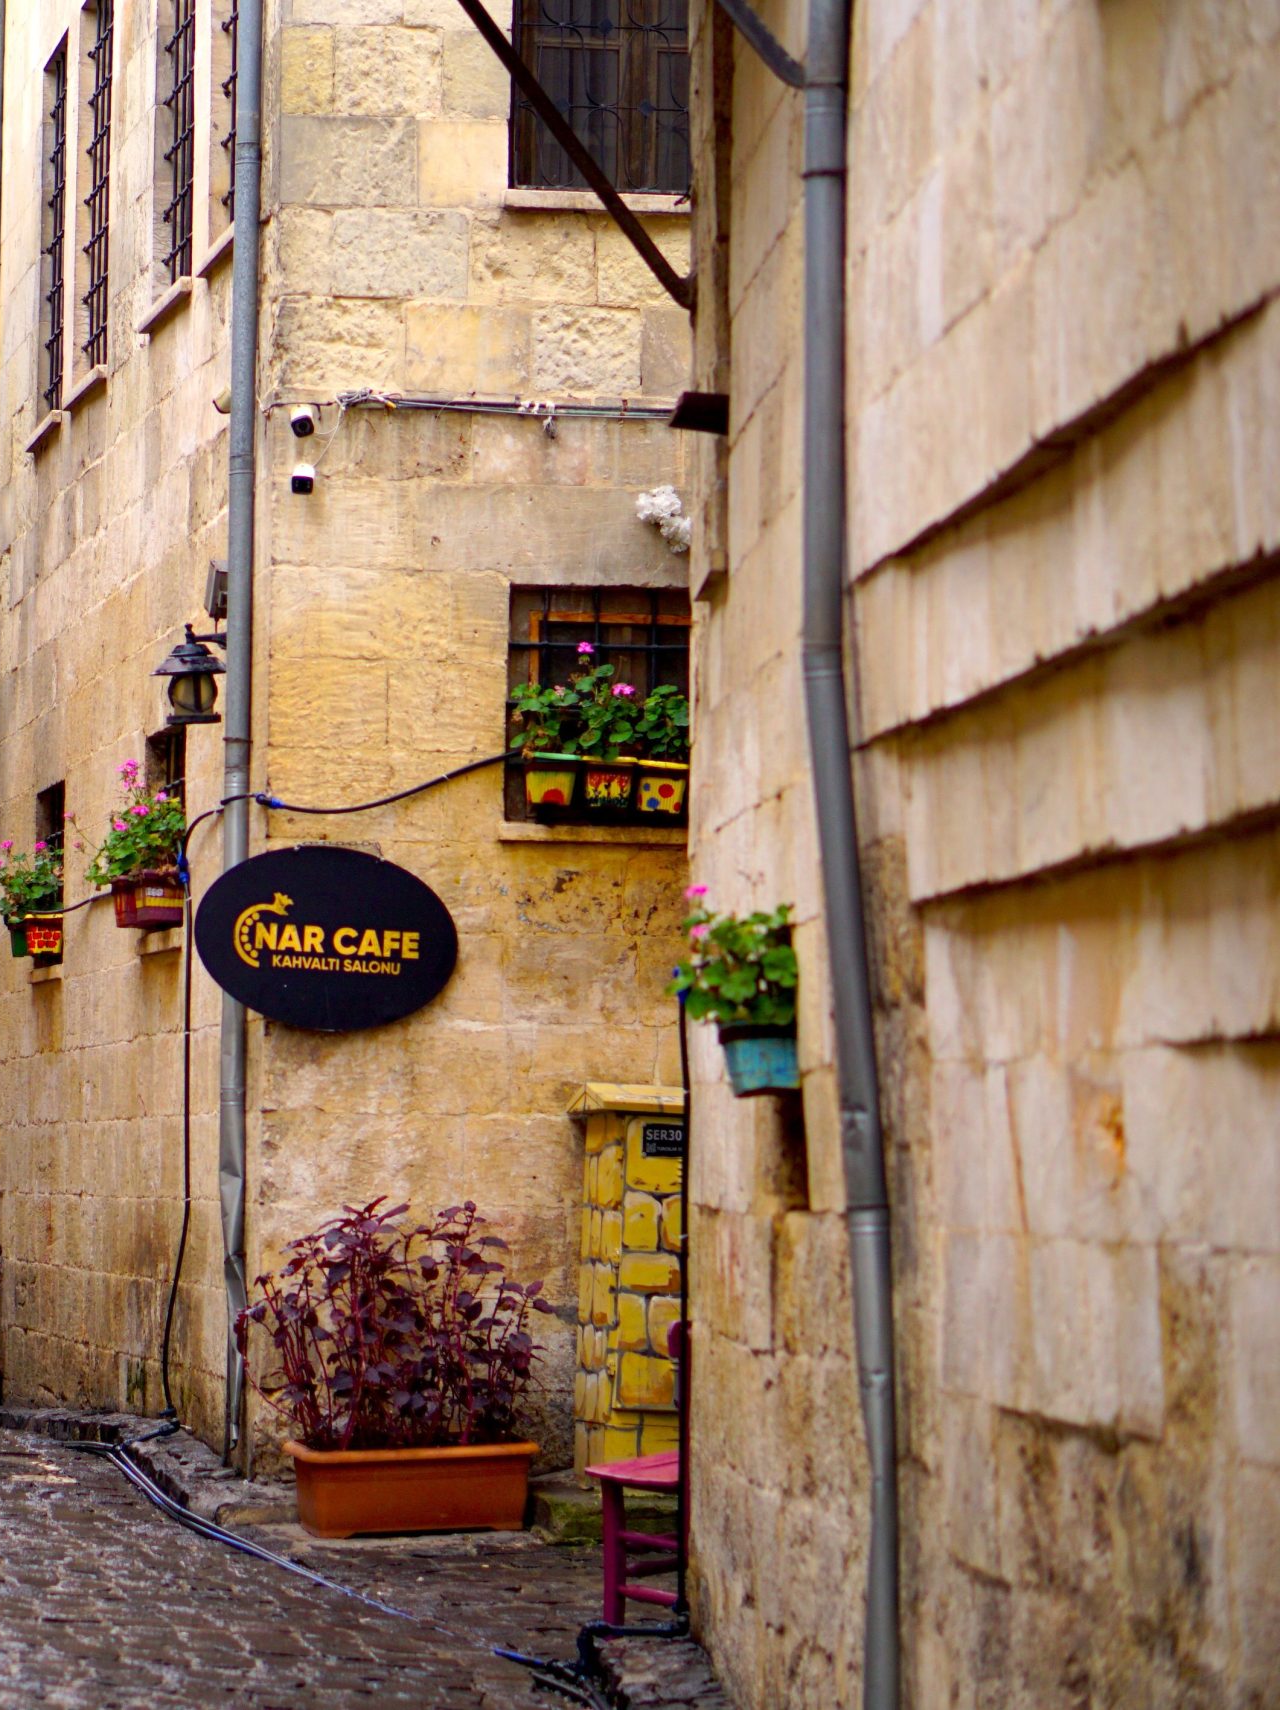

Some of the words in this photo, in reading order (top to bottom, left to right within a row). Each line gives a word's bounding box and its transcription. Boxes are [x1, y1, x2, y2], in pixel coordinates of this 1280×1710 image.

[255, 922, 325, 953] NAR
[333, 927, 420, 959] CAFE
[272, 954, 340, 971] KAHVALTI
[343, 959, 401, 975] SALONU
